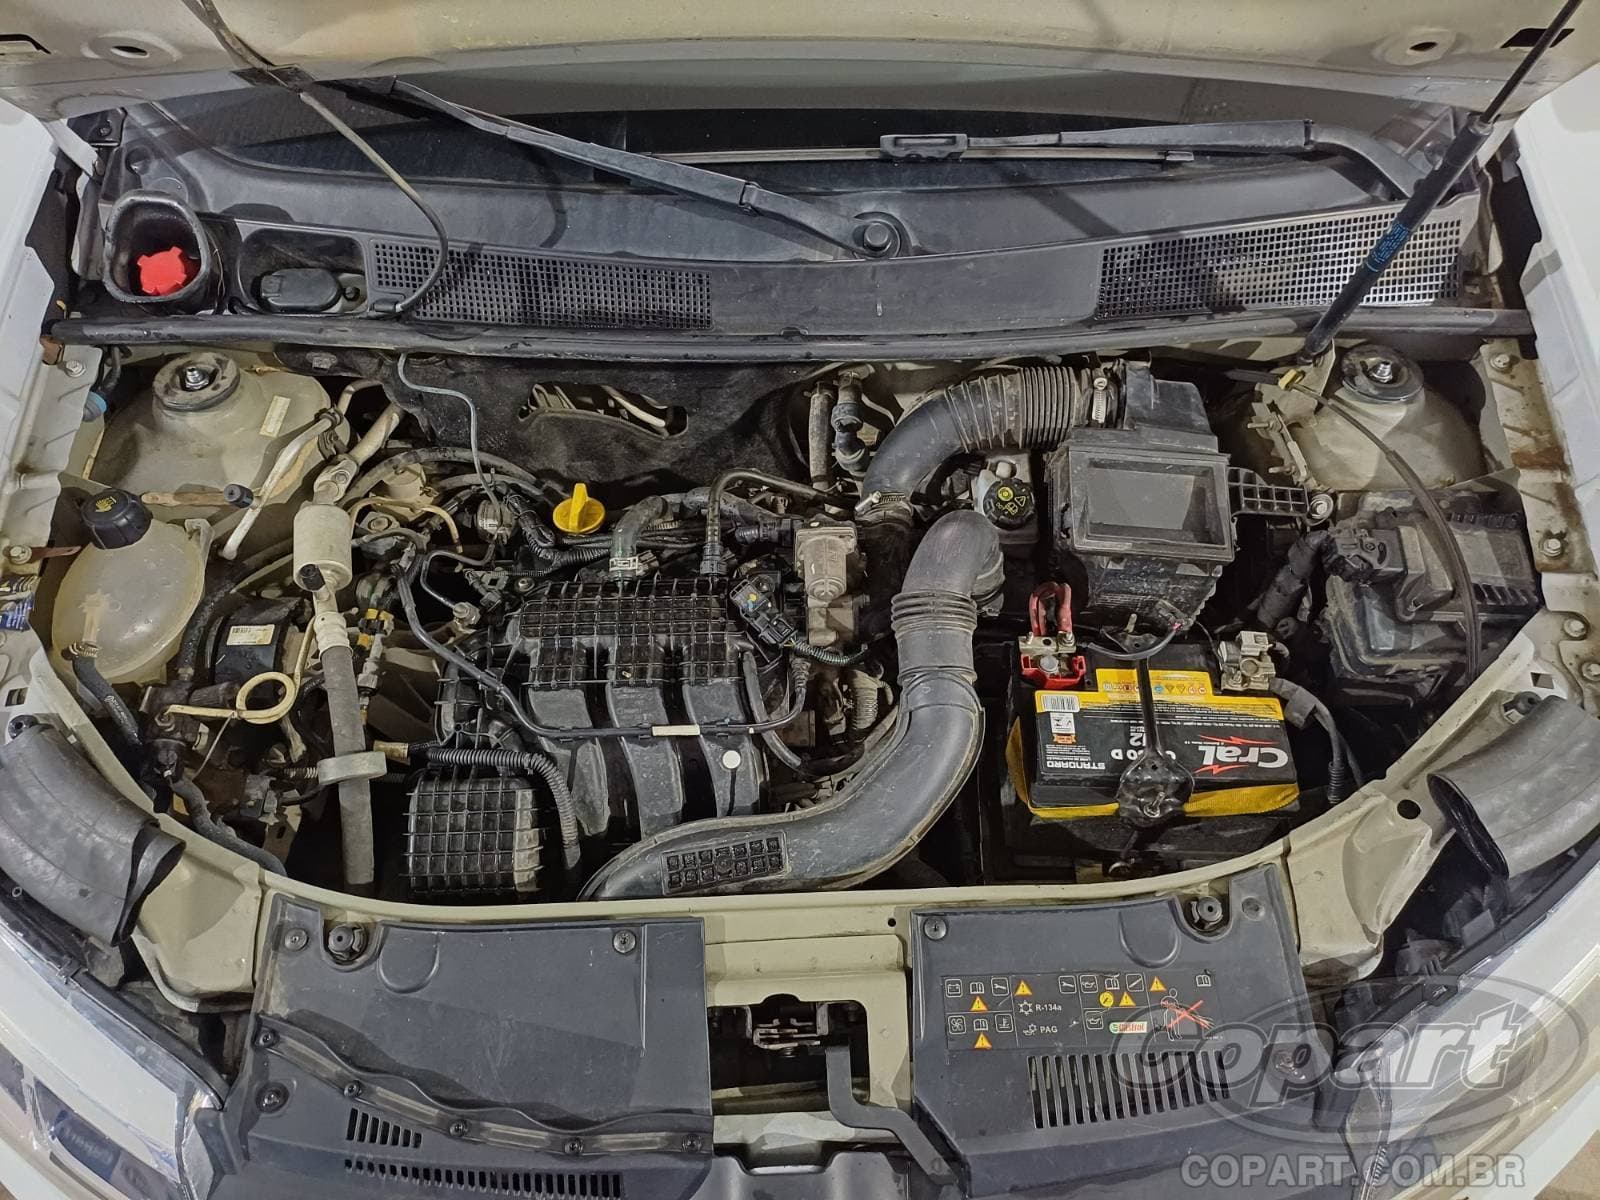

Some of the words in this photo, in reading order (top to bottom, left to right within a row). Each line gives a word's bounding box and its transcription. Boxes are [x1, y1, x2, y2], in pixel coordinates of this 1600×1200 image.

[1046, 760, 1106, 770] STANDARD
[1035, 1003, 1062, 1012] R-134a
[1040, 1025, 1058, 1034] PAG
